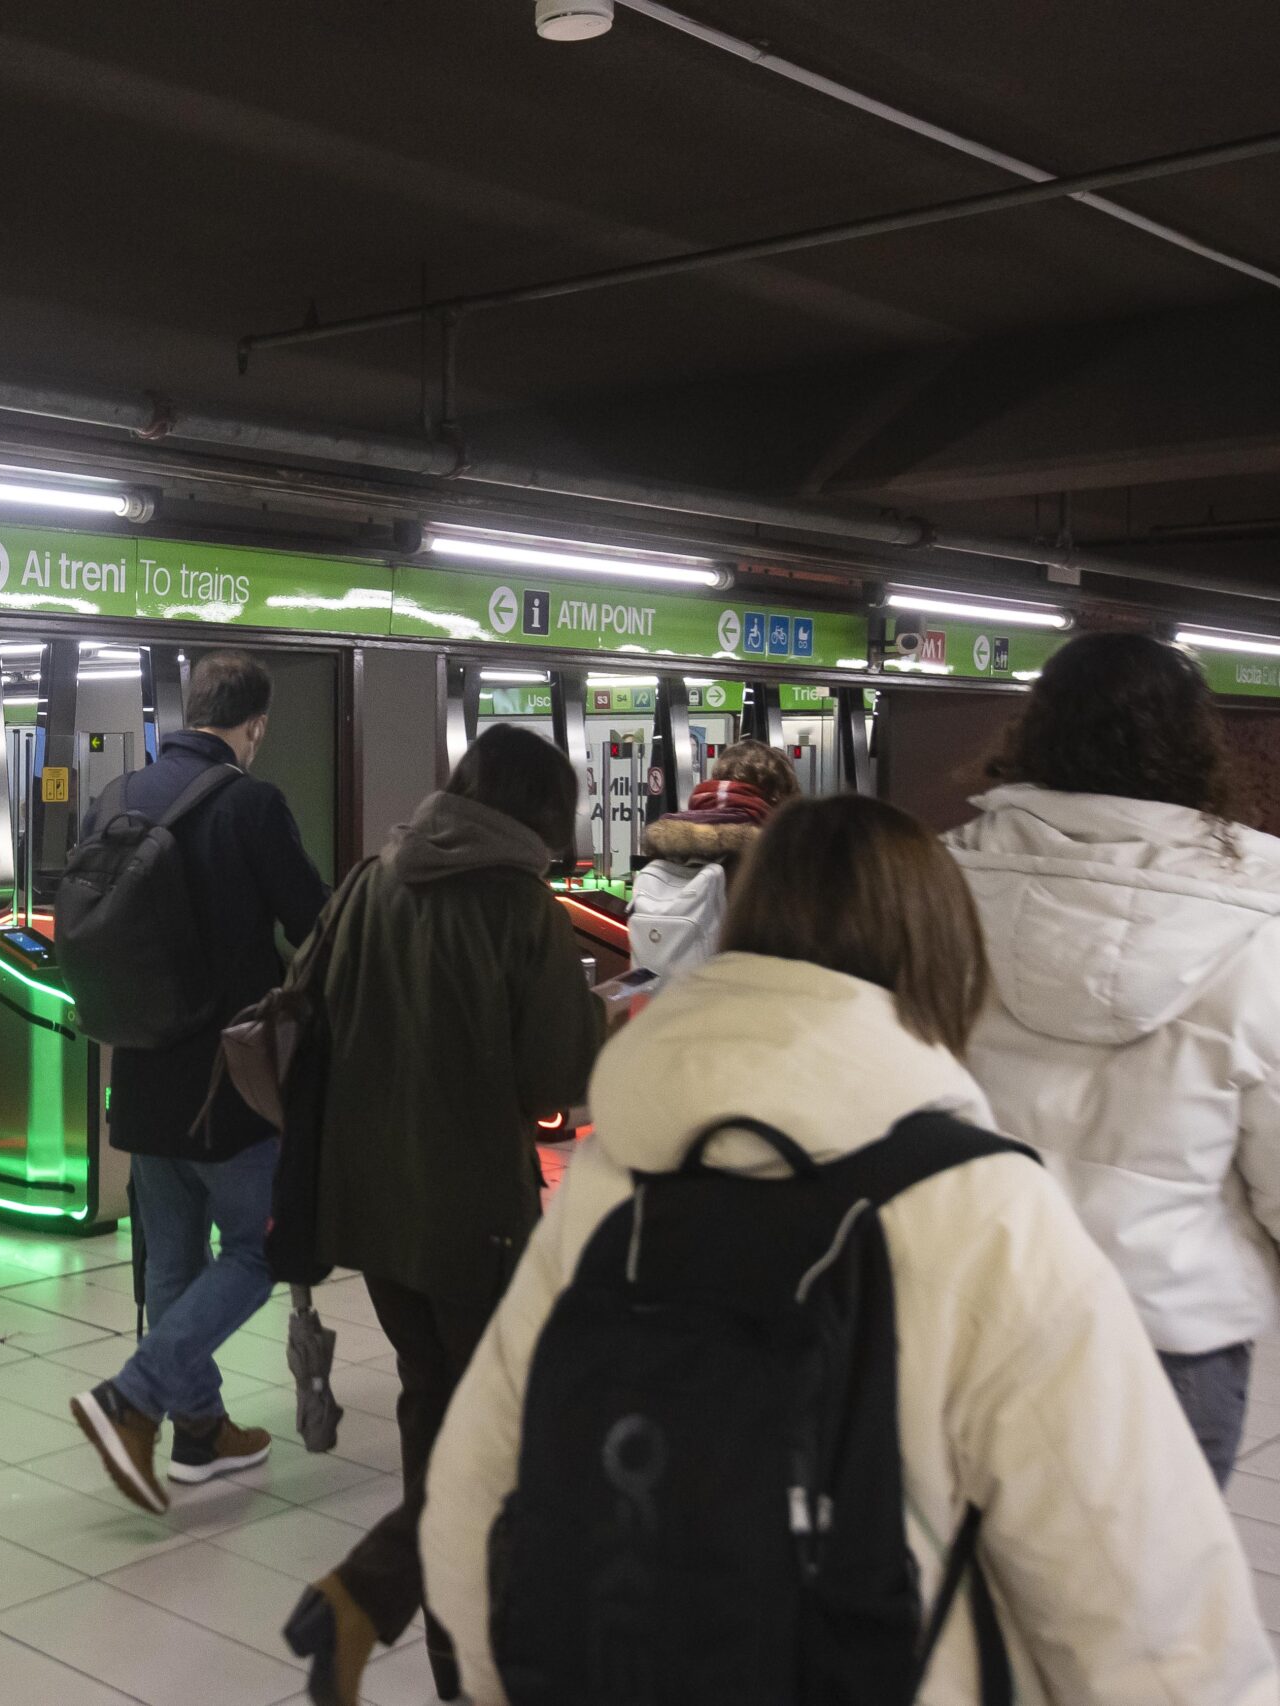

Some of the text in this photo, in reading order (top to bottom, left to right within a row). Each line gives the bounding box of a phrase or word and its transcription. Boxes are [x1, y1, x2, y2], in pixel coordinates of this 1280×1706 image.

[21, 550, 250, 604] Ai treni To trains
[557, 600, 597, 631] ATM
[601, 603, 656, 636] POINT
[528, 694, 551, 707] Usc
